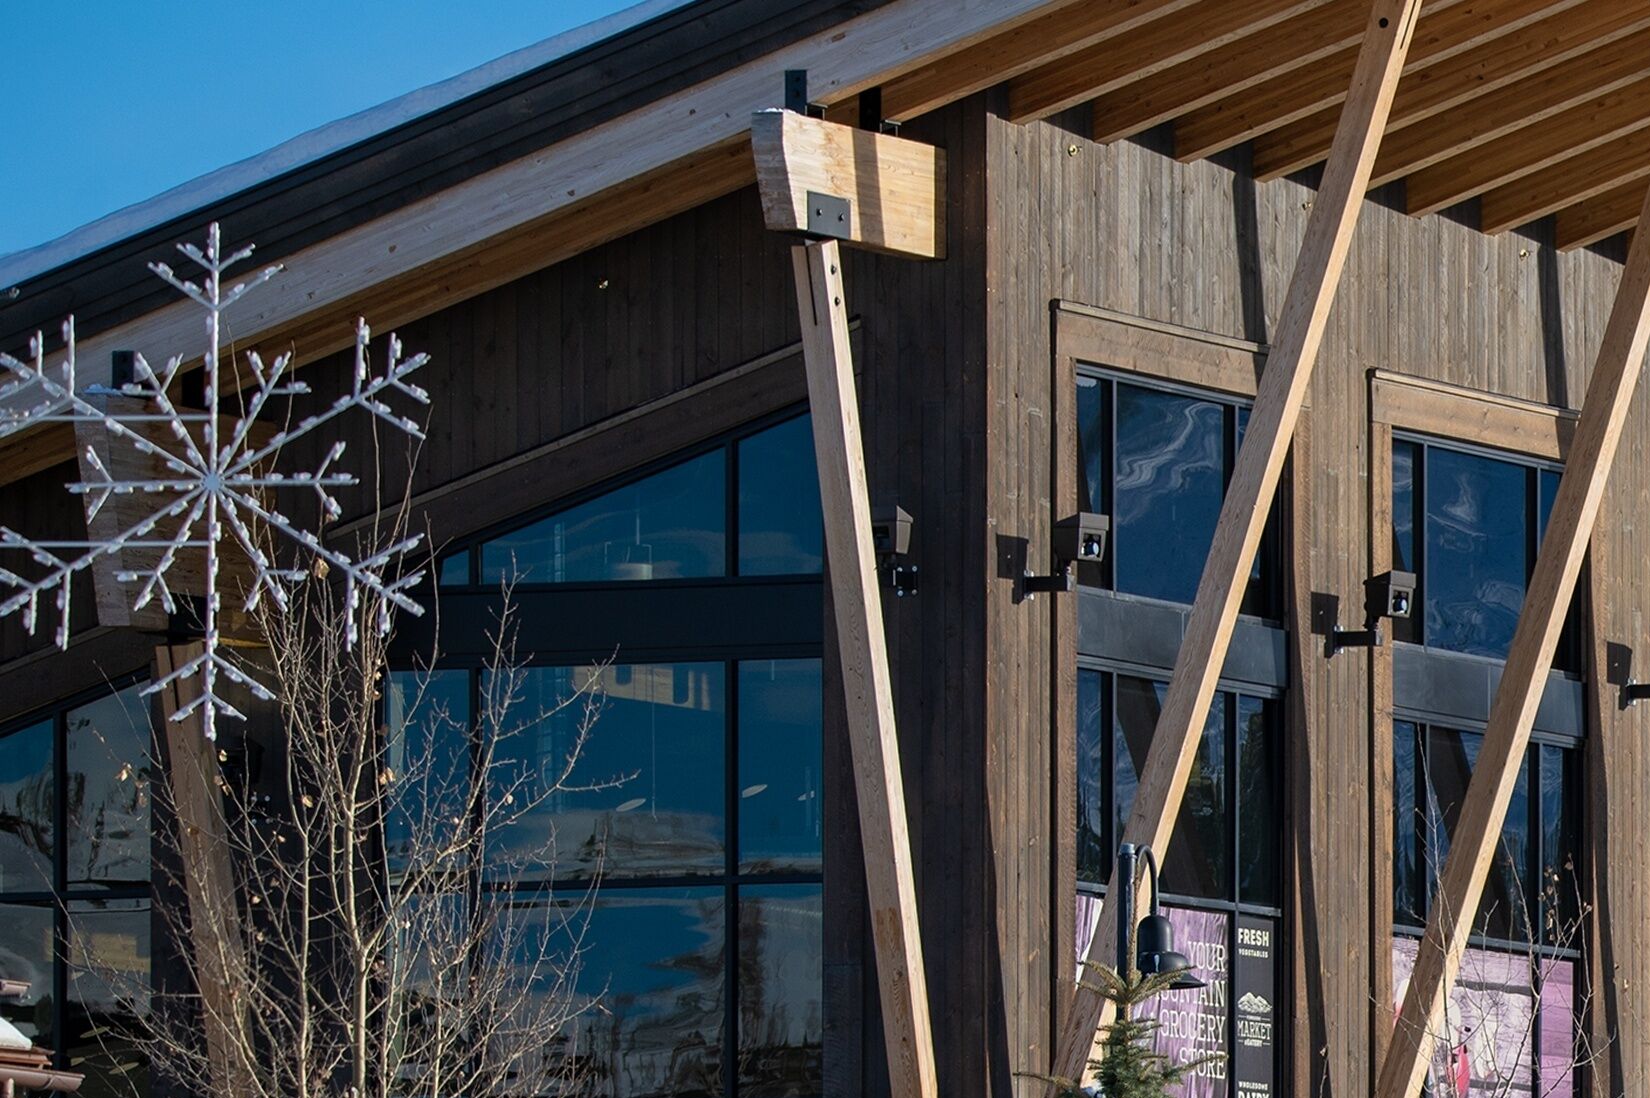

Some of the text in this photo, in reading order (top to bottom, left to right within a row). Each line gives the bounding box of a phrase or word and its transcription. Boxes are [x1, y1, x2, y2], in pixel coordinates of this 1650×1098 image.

[1238, 928, 1269, 947] FRESH
[1187, 941, 1225, 972] YOUR
[1160, 1009, 1225, 1043] GROCERY
[1237, 1020, 1272, 1040] MARKET
[1179, 1047, 1226, 1079] STORE
